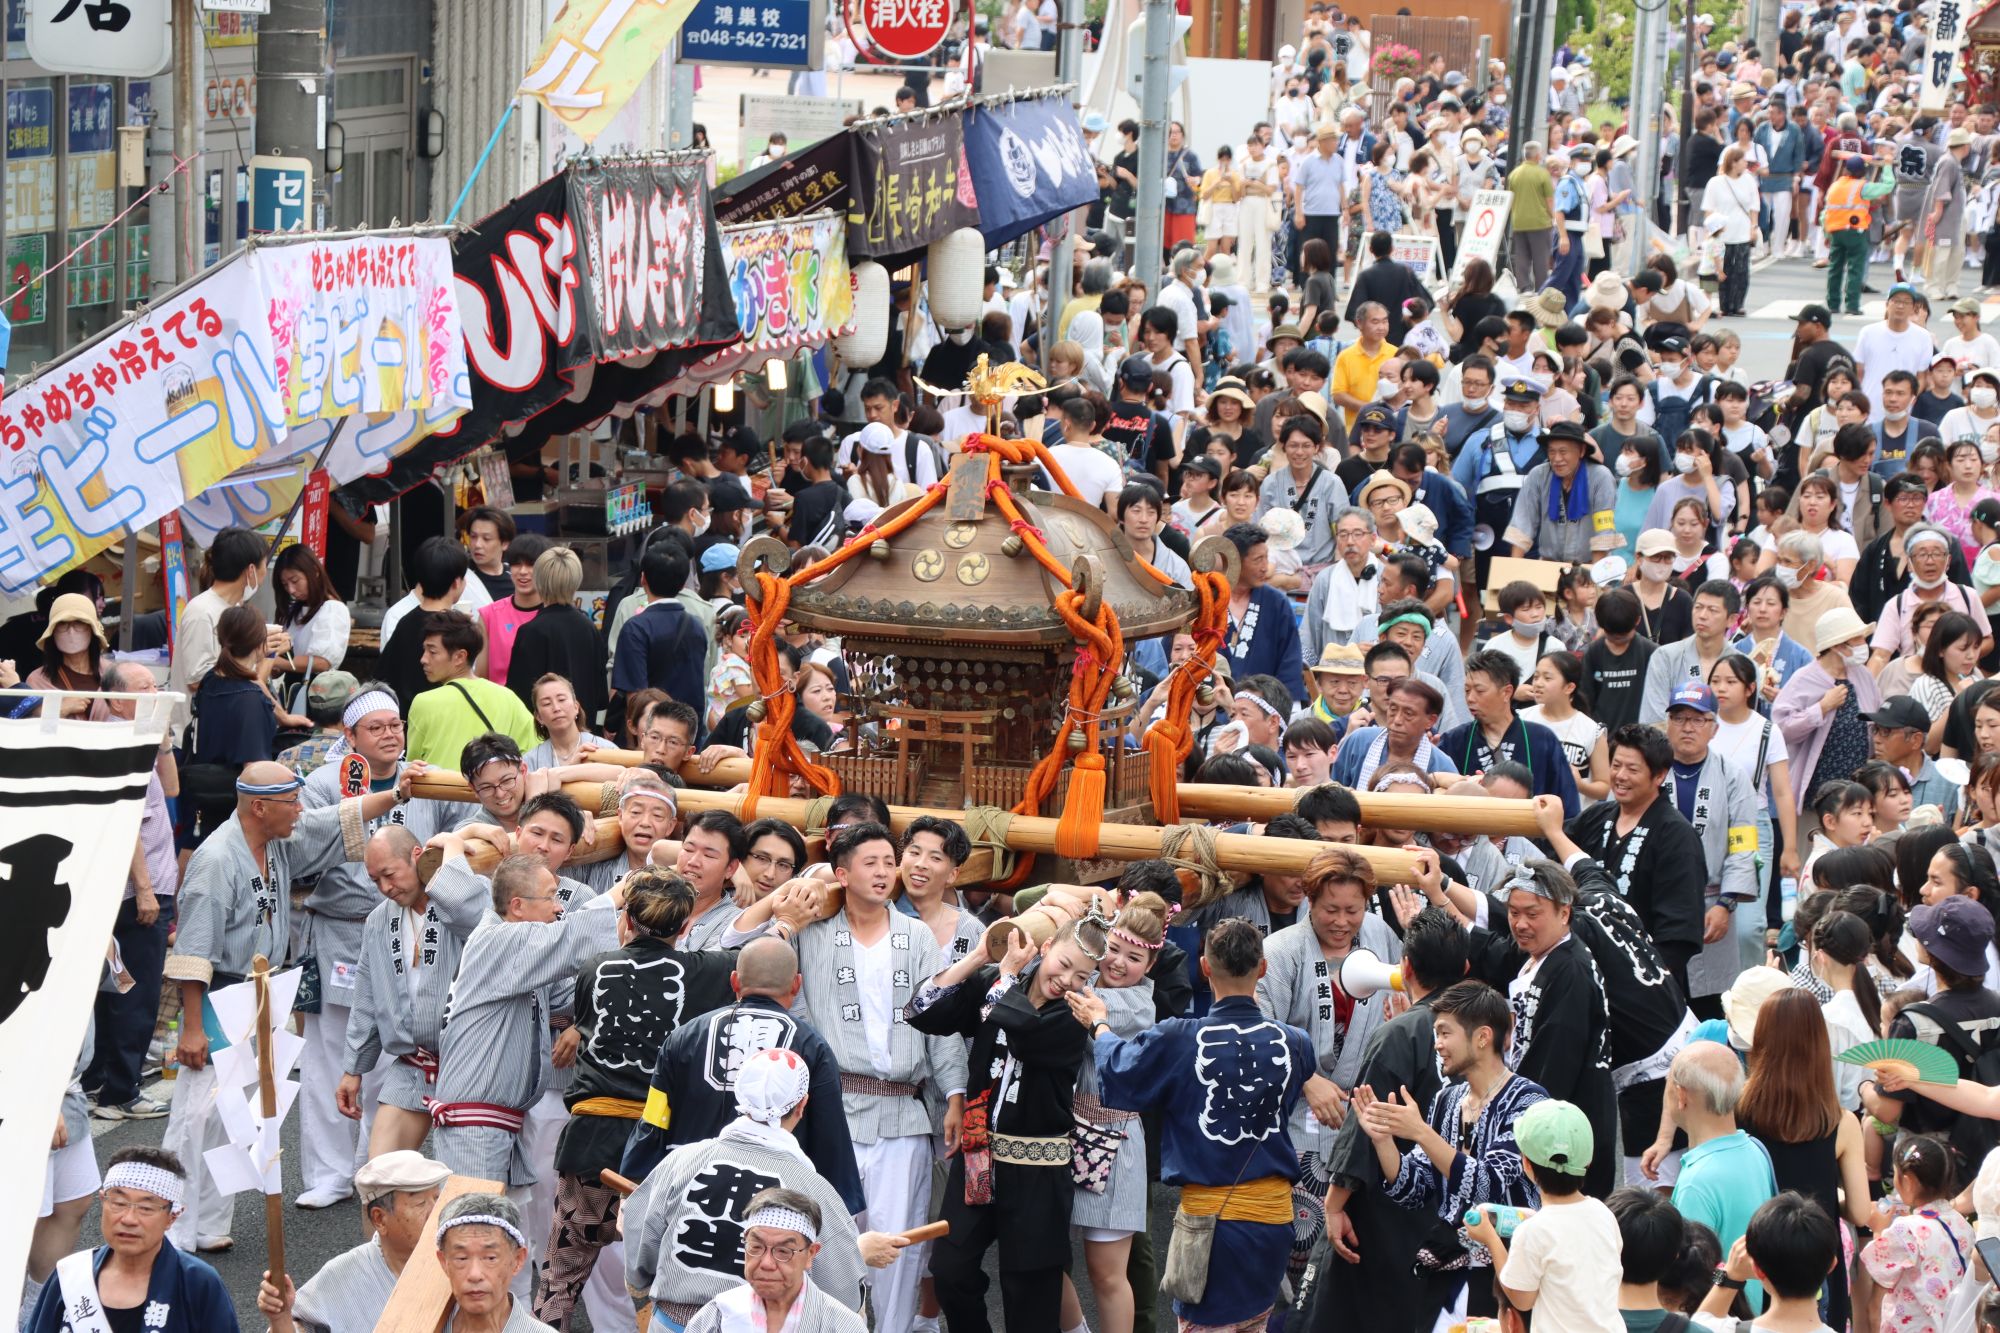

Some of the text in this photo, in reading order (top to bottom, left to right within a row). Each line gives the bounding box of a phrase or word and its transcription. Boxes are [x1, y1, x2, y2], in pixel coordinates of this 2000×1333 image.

[700, 29, 807, 51] 048-542-7321
[714, 5, 781, 28] 鴻巣校
[871, 0, 944, 29] 消火栓
[887, 158, 957, 240] 長崎和牛
[730, 248, 820, 338] かき氷
[835, 931, 861, 1021] 相生町
[1314, 960, 1332, 1022] 相生町
